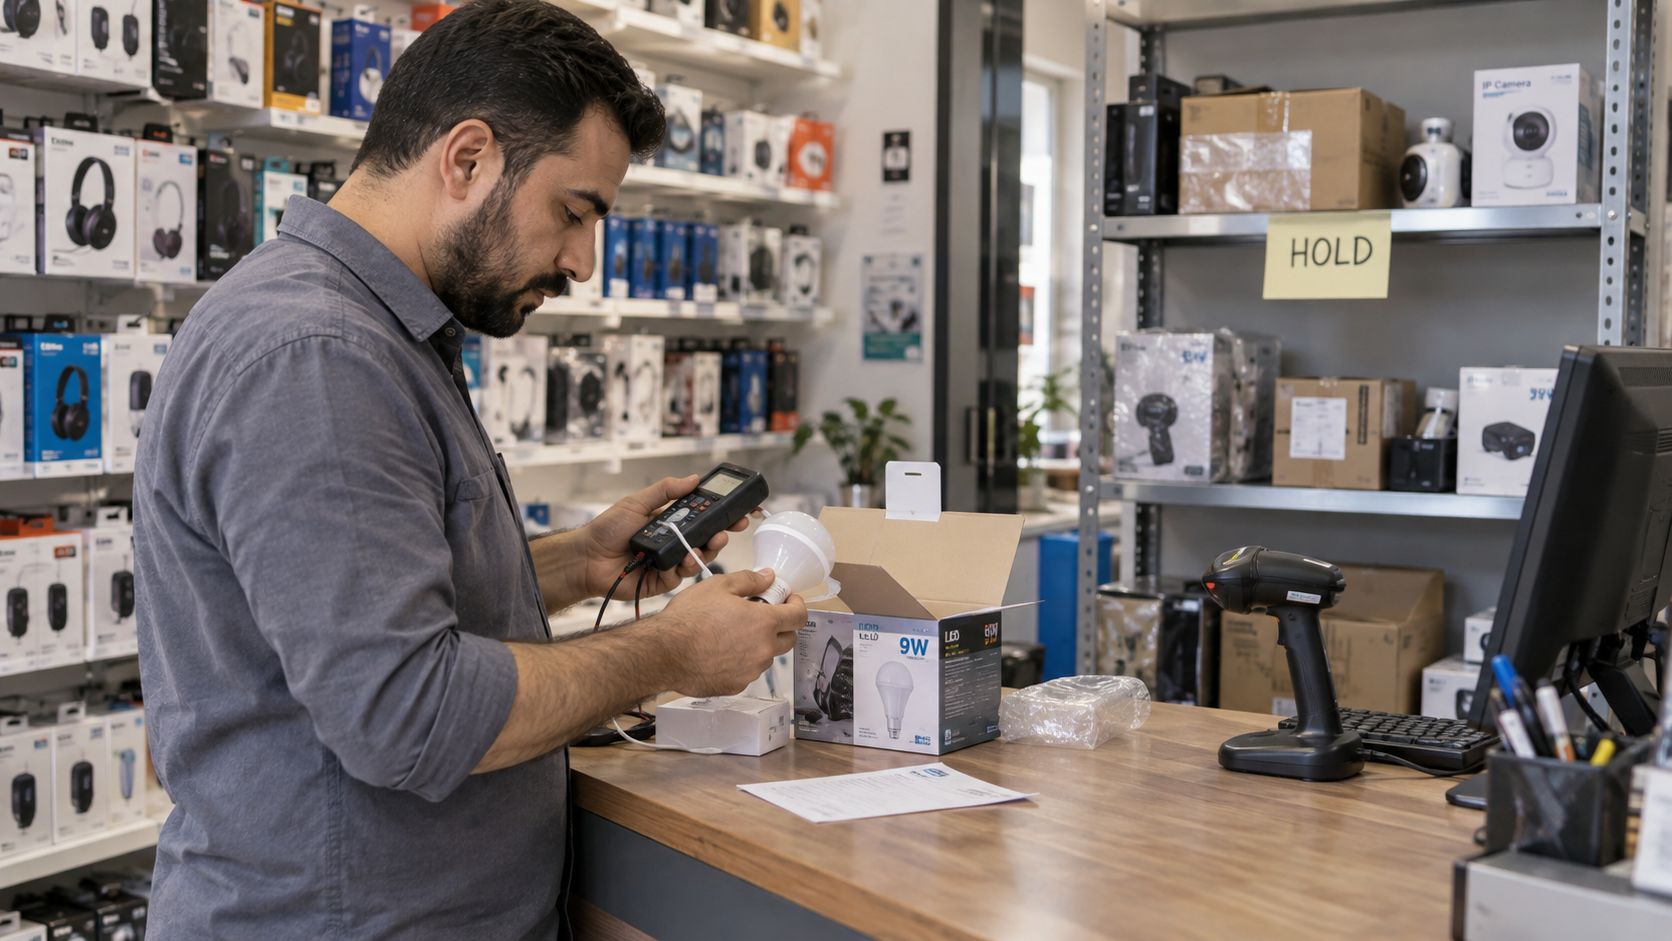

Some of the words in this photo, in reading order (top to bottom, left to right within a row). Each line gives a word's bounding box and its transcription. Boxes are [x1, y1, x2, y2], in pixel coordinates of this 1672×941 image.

[1482, 81, 1492, 90] IP
[1494, 80, 1531, 89] Camera
[1291, 236, 1373, 267] HOLD
[899, 637, 929, 656] 9W
